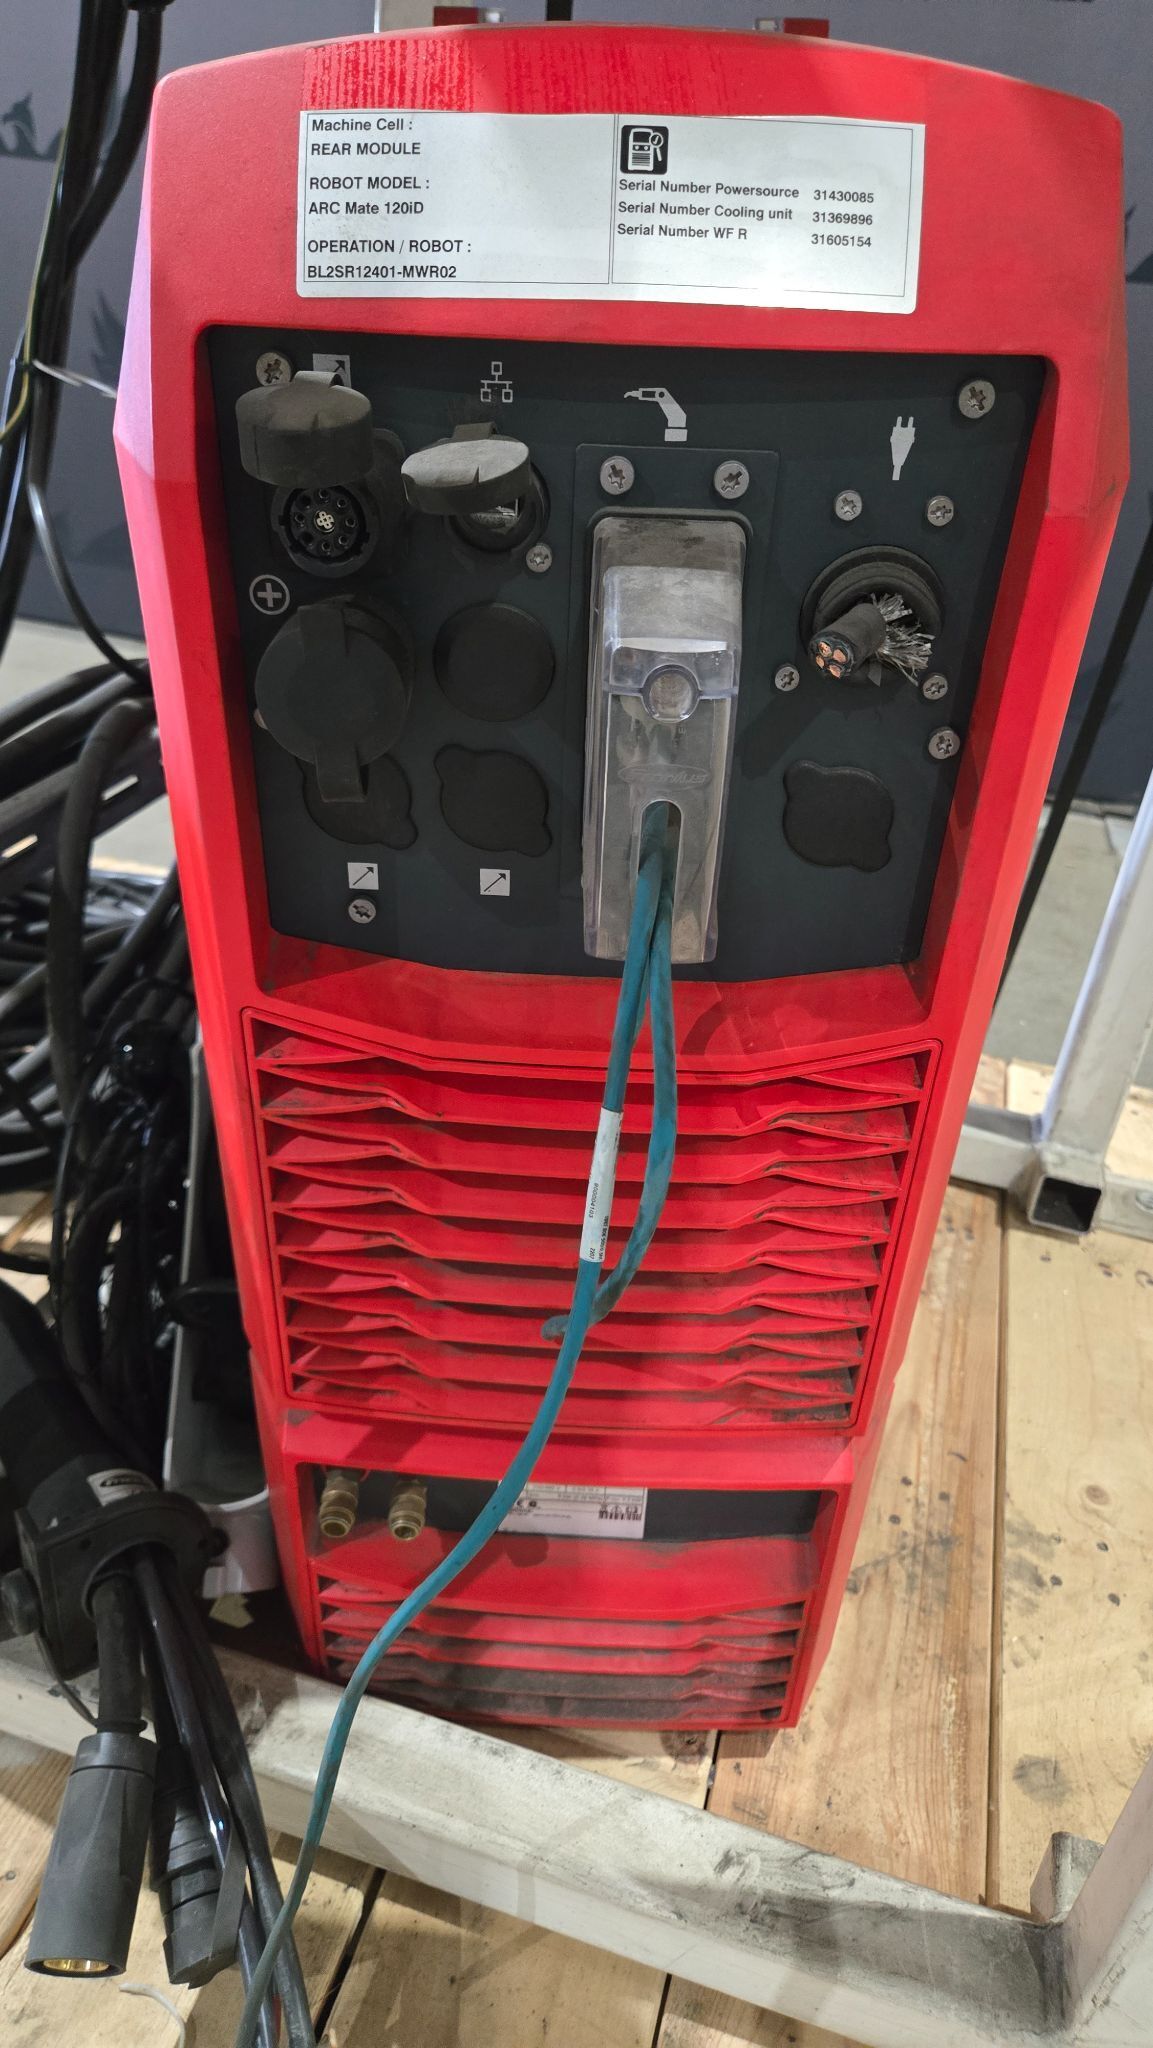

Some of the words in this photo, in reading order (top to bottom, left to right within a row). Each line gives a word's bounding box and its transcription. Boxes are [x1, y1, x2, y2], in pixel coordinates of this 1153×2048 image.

[312, 119, 371, 131] Machine
[377, 118, 403, 130] Cell
[311, 143, 351, 155] REAR
[357, 142, 420, 155] MODULE
[310, 177, 362, 189] ROBOT
[368, 177, 421, 189] MODEL
[619, 179, 655, 191] Serial
[661, 181, 711, 193] Number
[716, 183, 799, 198] Powersource
[814, 190, 874, 203] 31430085
[309, 202, 340, 214] ARC
[346, 202, 379, 214] Mate
[385, 202, 423, 214] 120iD
[618, 201, 655, 213] Serial
[660, 203, 710, 216] Number
[715, 205, 764, 221] Cooling
[769, 208, 792, 219] unit
[813, 212, 872, 225] 31369896
[618, 223, 654, 235] Serial
[659, 225, 709, 238] Number
[714, 227, 734, 239] WF
[738, 228, 747, 239] R
[811, 234, 871, 247] 31605154
[308, 240, 394, 253] OPERATION
[409, 240, 463, 252] ROBOT
[308, 265, 456, 278] BL2SR12401-MWR02
